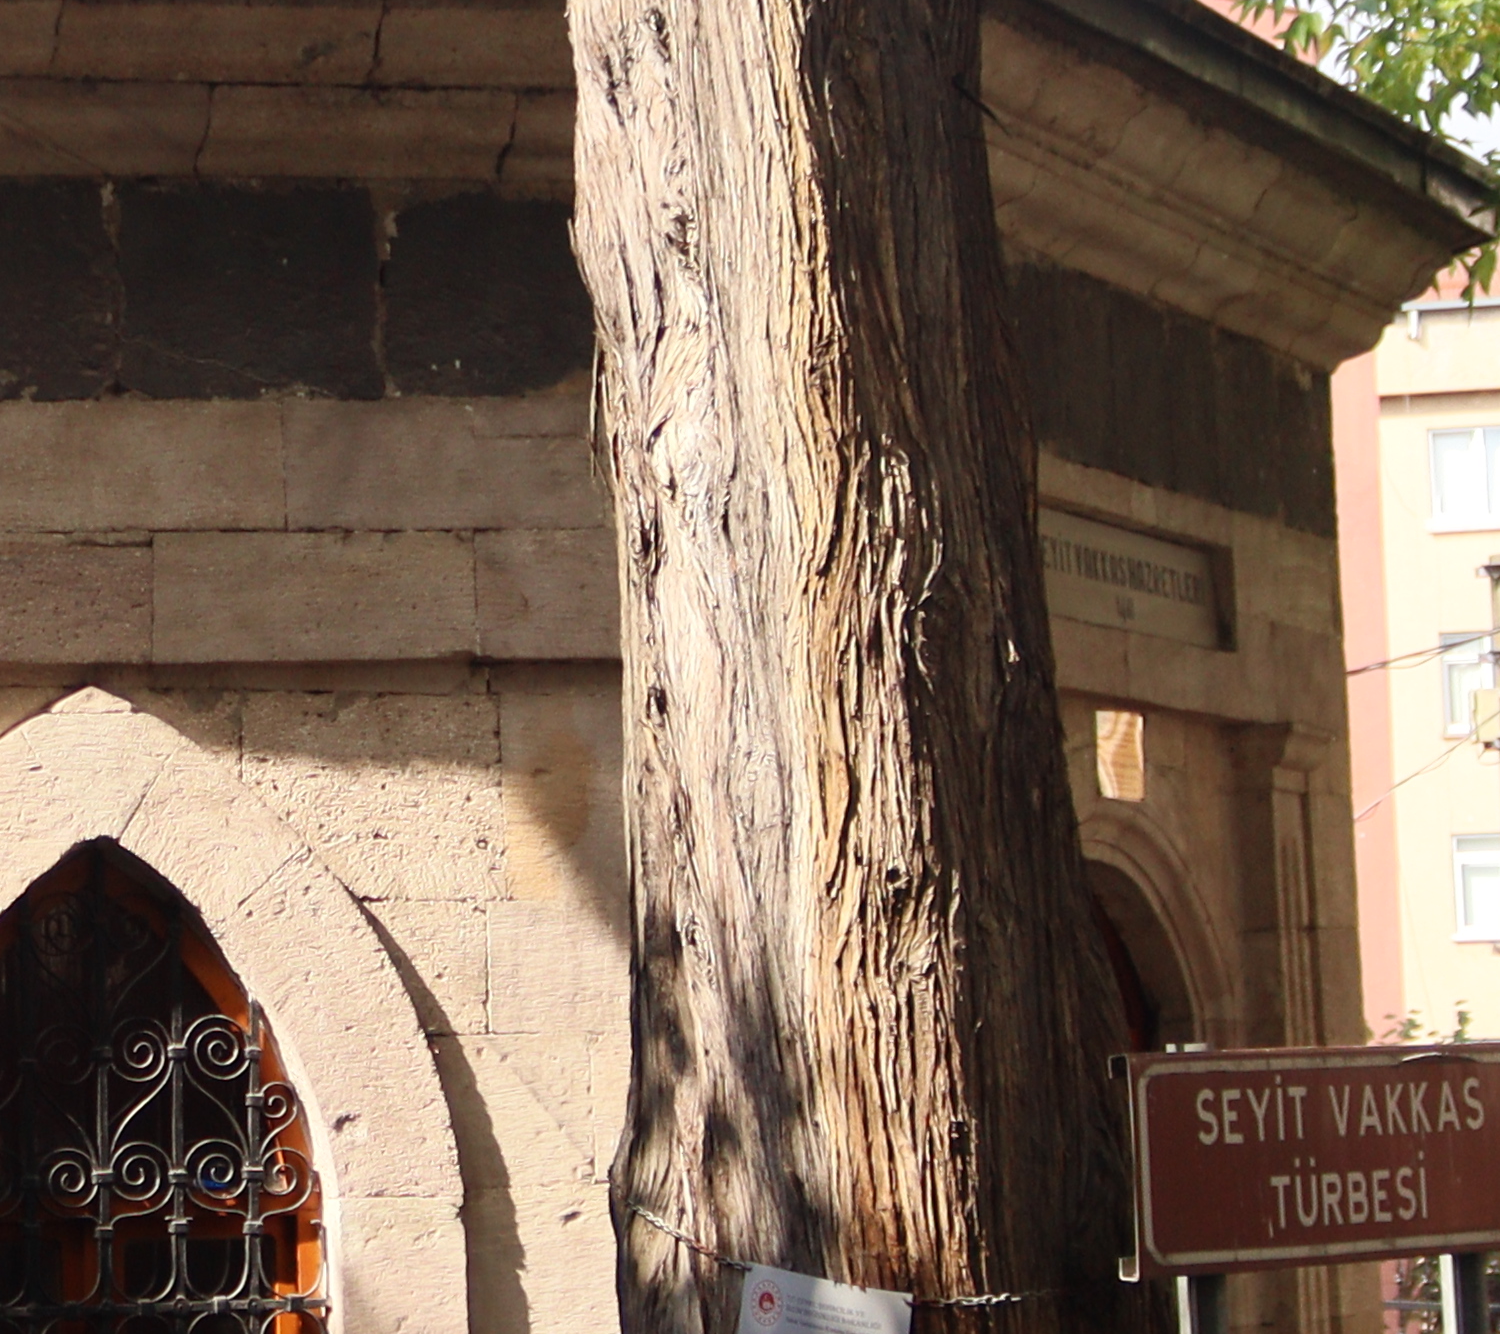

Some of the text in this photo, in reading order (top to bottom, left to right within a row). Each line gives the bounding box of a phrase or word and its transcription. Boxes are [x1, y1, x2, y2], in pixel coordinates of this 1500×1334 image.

[1041, 532, 1072, 575] EYİT
[1196, 1075, 1486, 1146] SEYİT VAKKAS
[1270, 1151, 1429, 1229] TÜRBESİ
